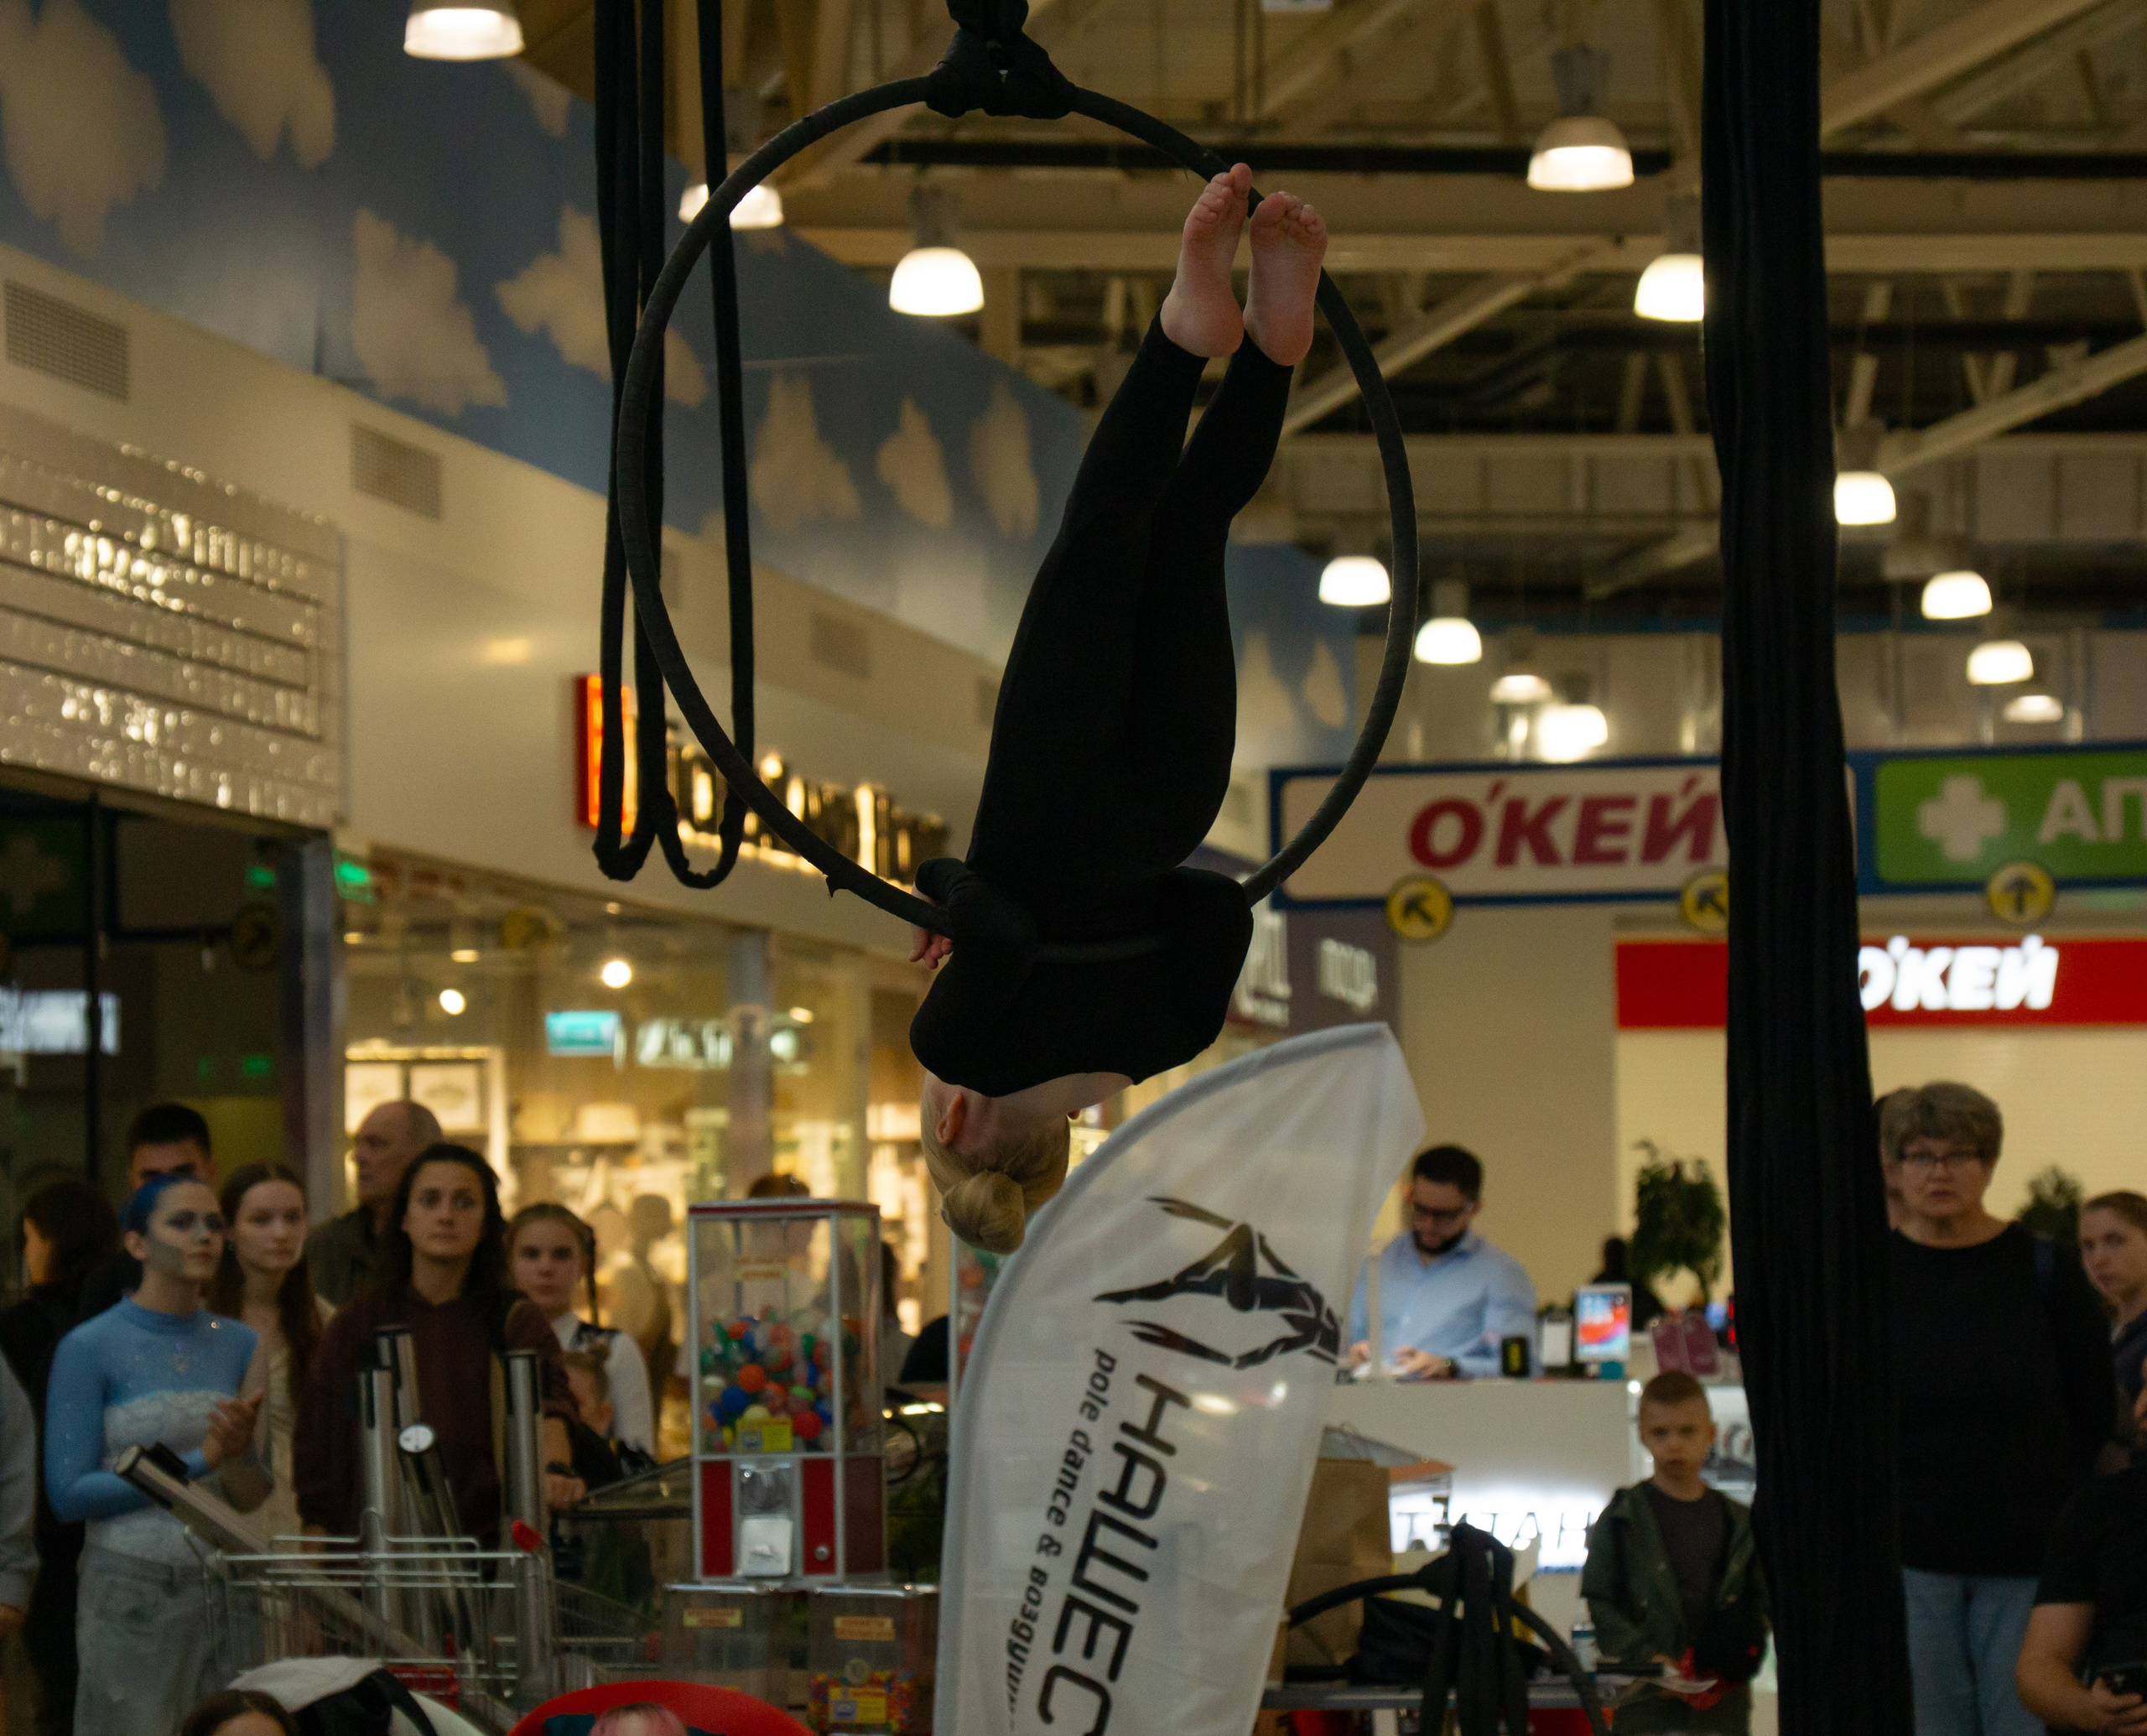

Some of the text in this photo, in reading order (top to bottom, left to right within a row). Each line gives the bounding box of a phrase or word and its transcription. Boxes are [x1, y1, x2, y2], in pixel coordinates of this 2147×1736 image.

[1409, 775, 1718, 869] О'КЕЙ
[1079, 1348, 1117, 1422] pole
[1047, 1428, 1094, 1526] dance
[1036, 1534, 1063, 1557] &
[1396, 1511, 1593, 1551] ТТАН
